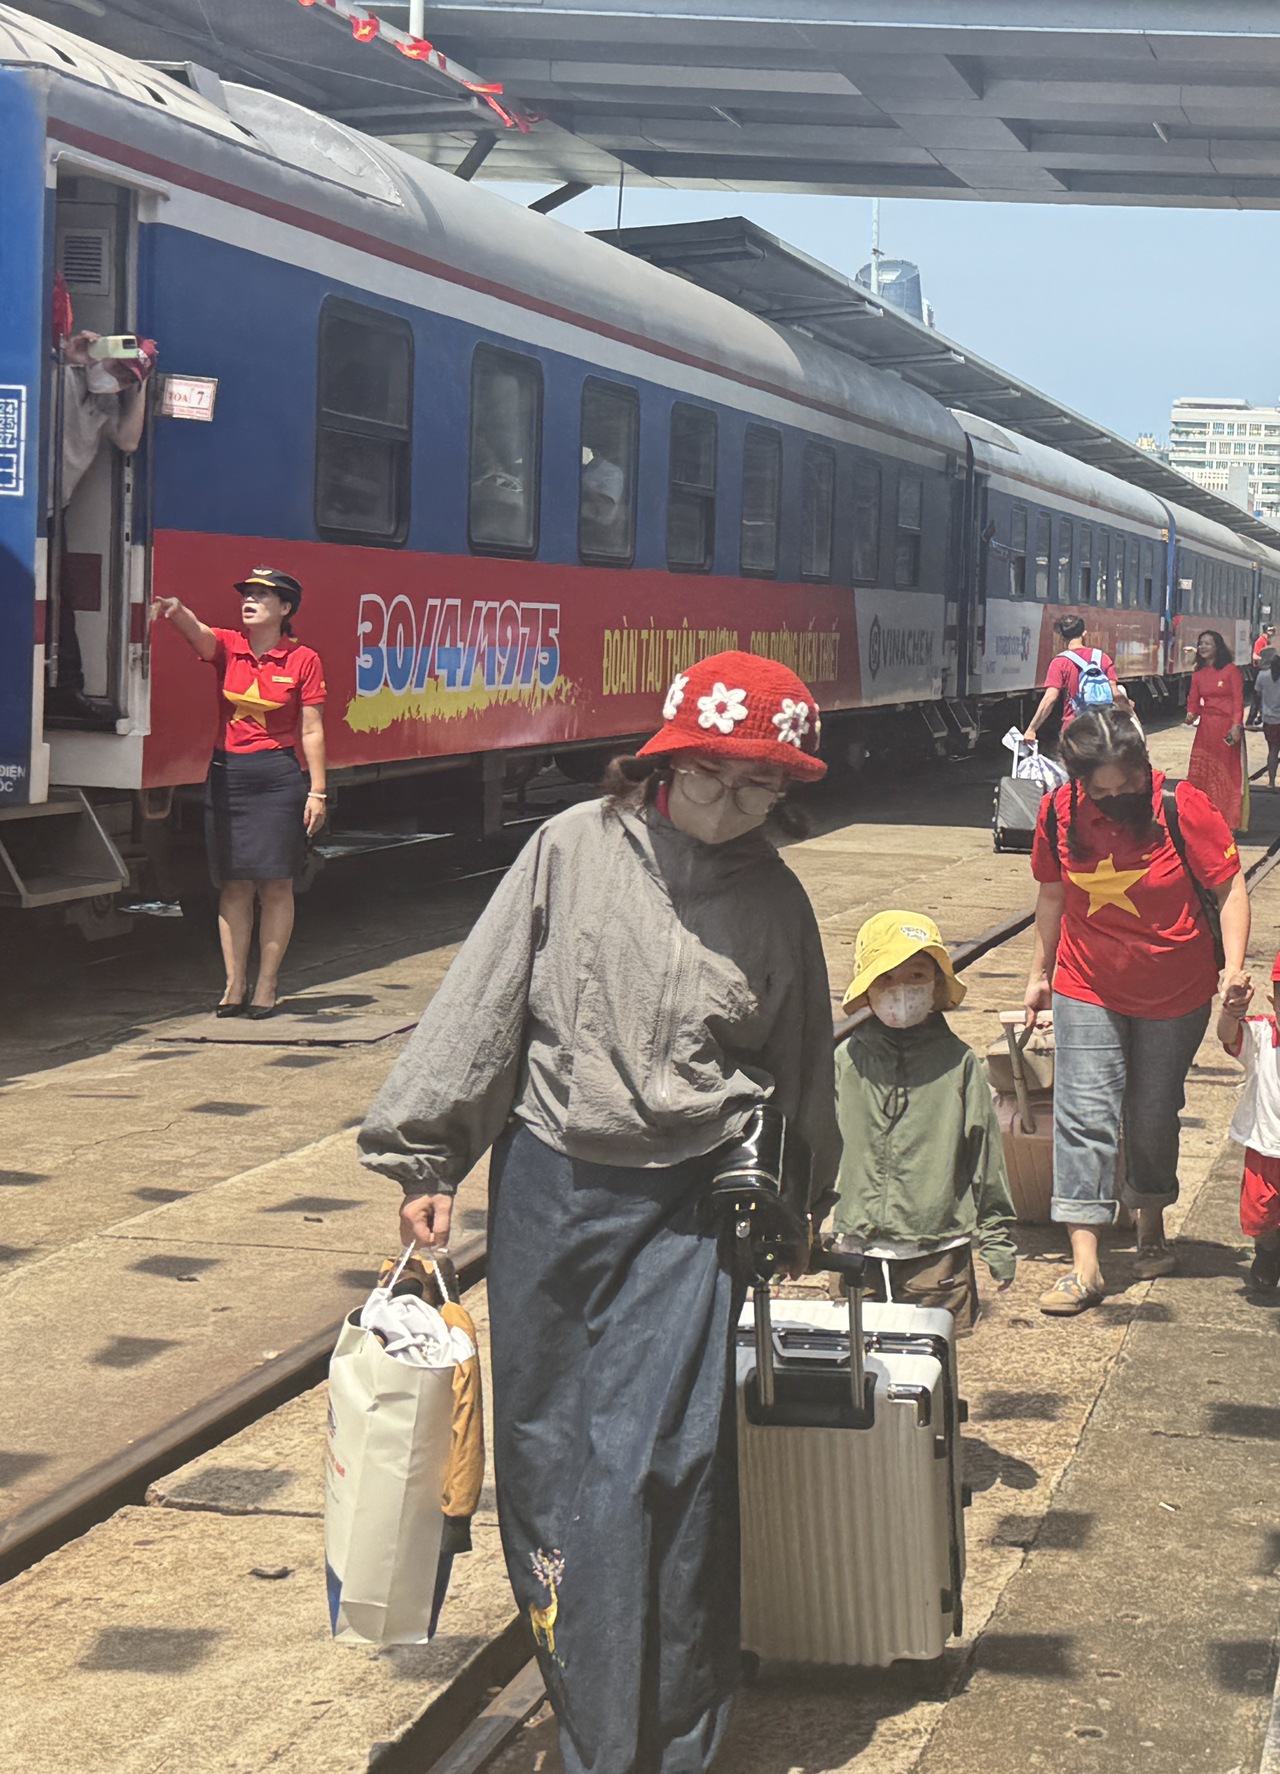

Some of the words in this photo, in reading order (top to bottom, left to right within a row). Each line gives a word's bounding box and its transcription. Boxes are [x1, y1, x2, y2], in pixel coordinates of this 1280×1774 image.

[197, 391, 205, 406] 7
[356, 593, 560, 697] 30/4/1975
[602, 616, 638, 695] ĐOÀN
[640, 616, 664, 693] TÀU
[882, 629, 935, 667] VINACHEM
